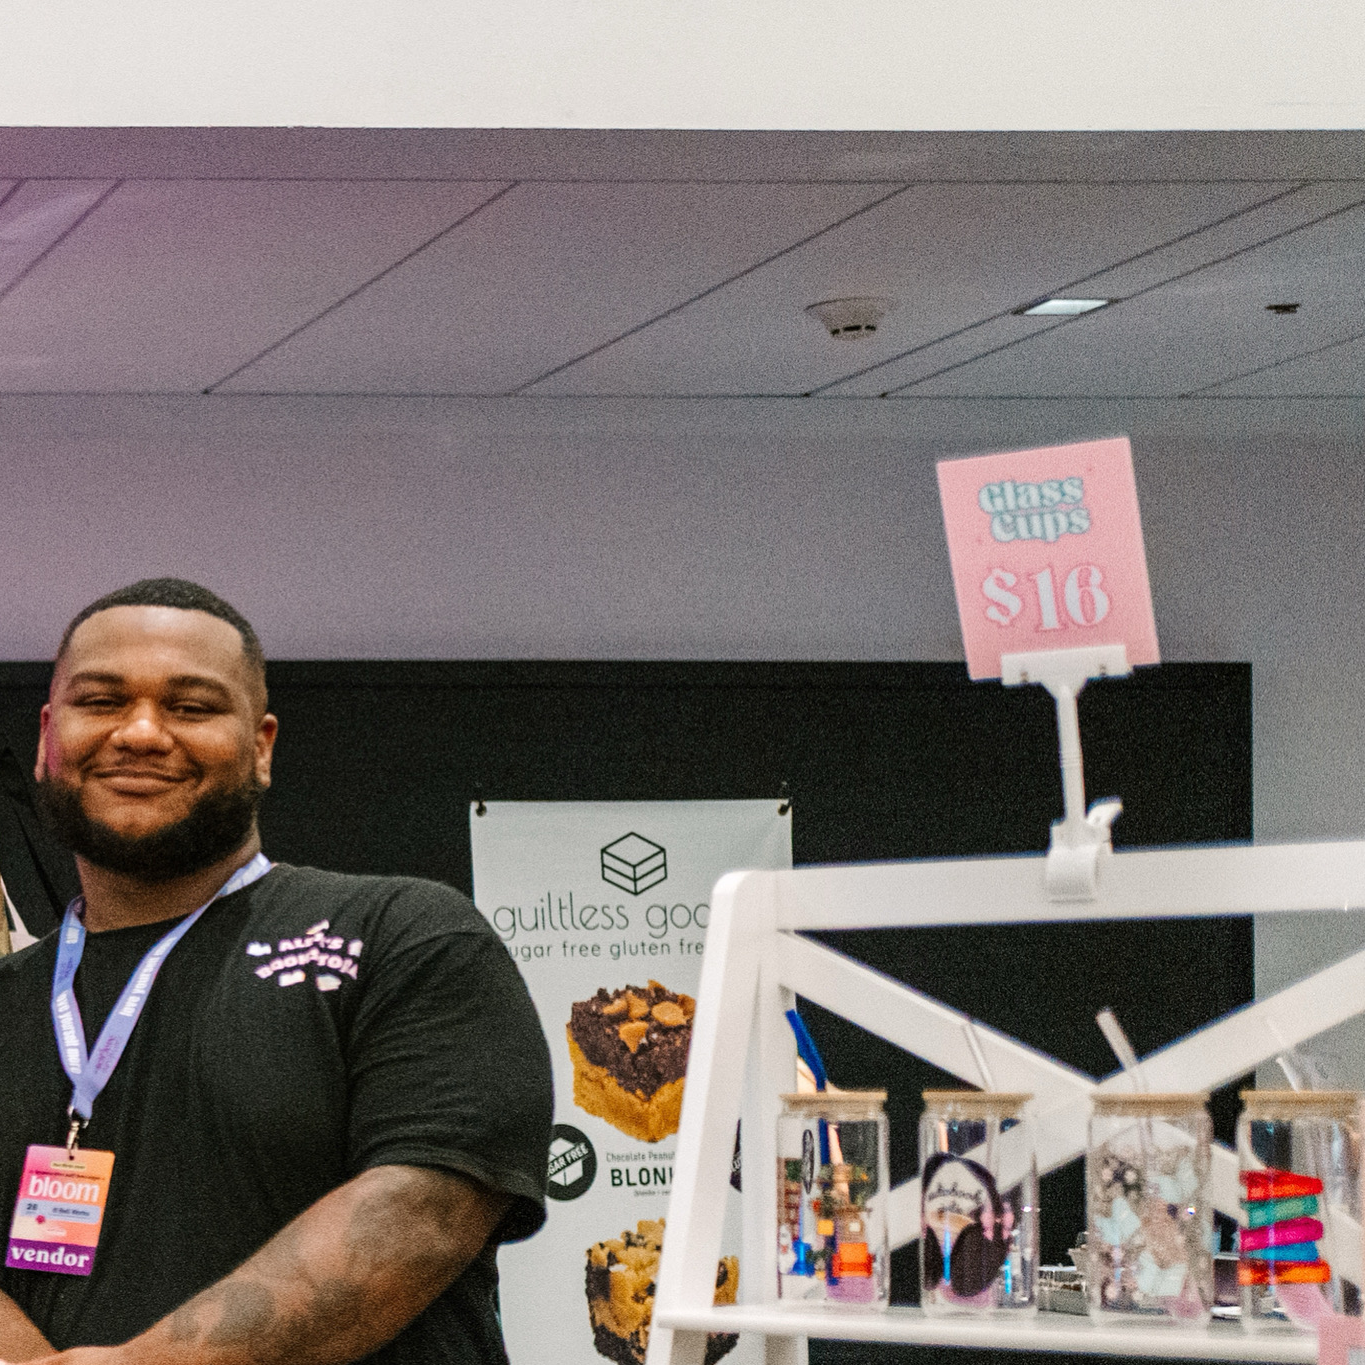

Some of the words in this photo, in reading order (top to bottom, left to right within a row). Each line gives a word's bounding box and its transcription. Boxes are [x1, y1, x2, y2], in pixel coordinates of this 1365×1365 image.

[979, 477, 1084, 514] Glass
[991, 507, 1091, 543] Cups
[982, 563, 1113, 633] $16
[494, 891, 629, 941] guiltless
[508, 944, 553, 962] ugar
[563, 940, 601, 957] free
[609, 940, 670, 960] gluten
[680, 938, 705, 955] fre
[566, 1141, 589, 1163] FREE
[29, 1174, 100, 1202] bloom
[10, 1246, 90, 1268] vendor
